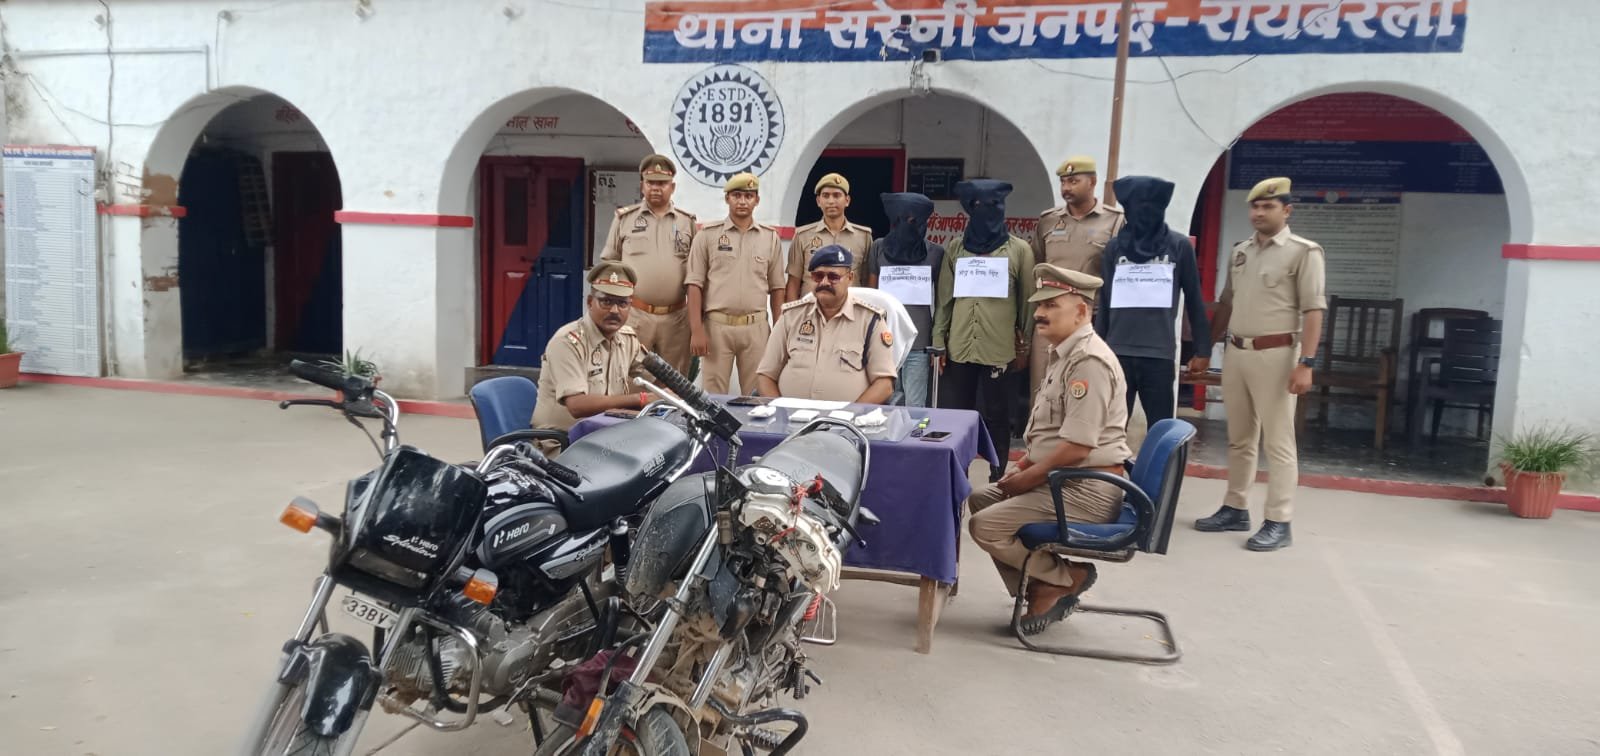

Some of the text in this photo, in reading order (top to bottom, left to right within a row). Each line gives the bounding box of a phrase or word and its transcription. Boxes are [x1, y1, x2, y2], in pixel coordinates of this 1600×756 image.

[673, 12, 817, 49] थाना
[706, 87, 747, 101] ESTD
[698, 102, 753, 123] 1891
